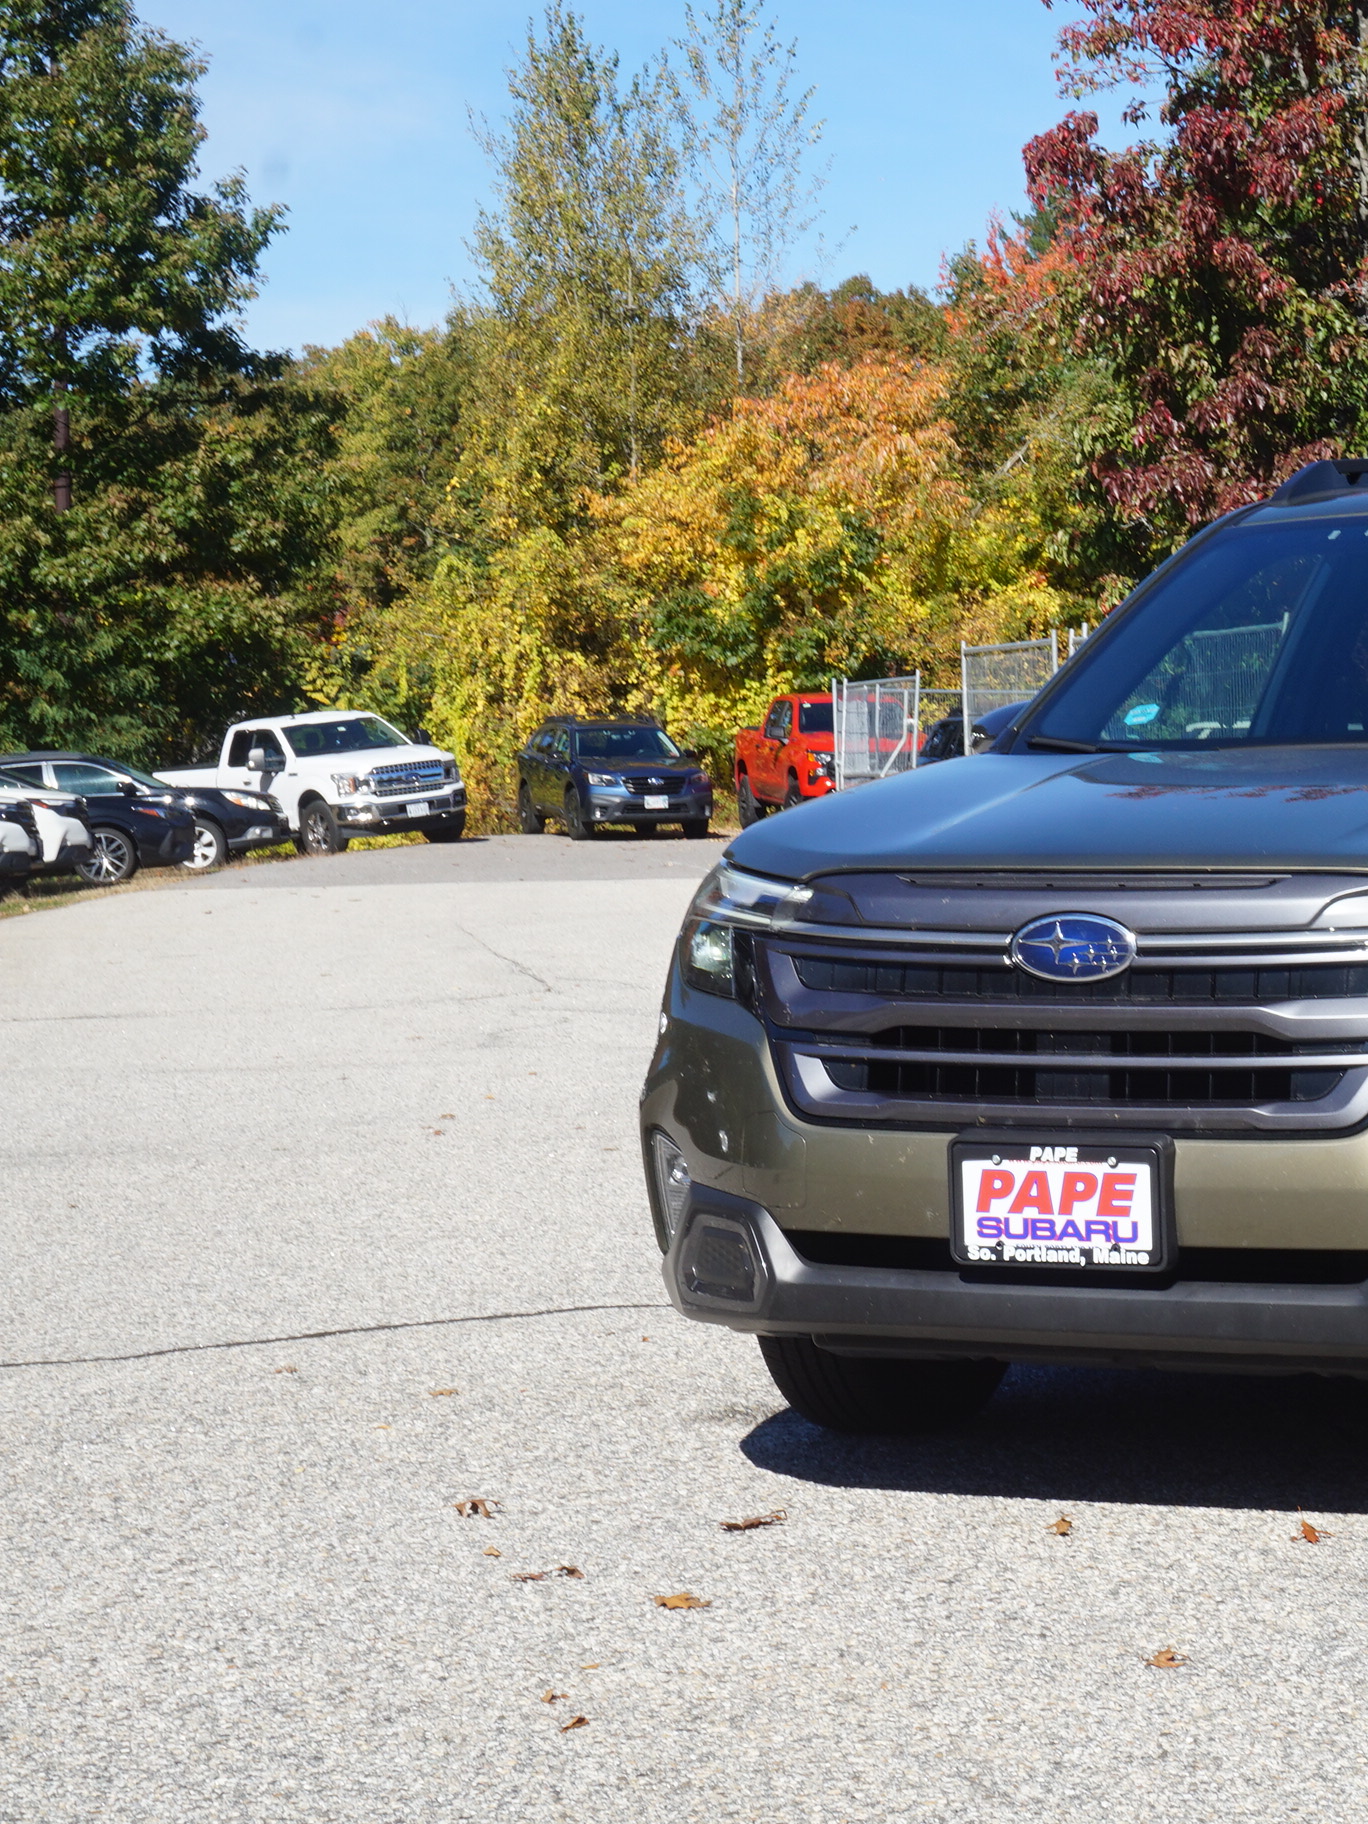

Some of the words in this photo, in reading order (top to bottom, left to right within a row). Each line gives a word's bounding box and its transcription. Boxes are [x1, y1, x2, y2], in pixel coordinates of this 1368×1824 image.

[1030, 1146, 1078, 1163] PAPE
[976, 1169, 1137, 1217] PAPE
[976, 1217, 1138, 1243] SUBARU
[967, 1244, 996, 1261] So.
[1003, 1245, 1086, 1267] Portland,
[1092, 1247, 1150, 1265] Maine
